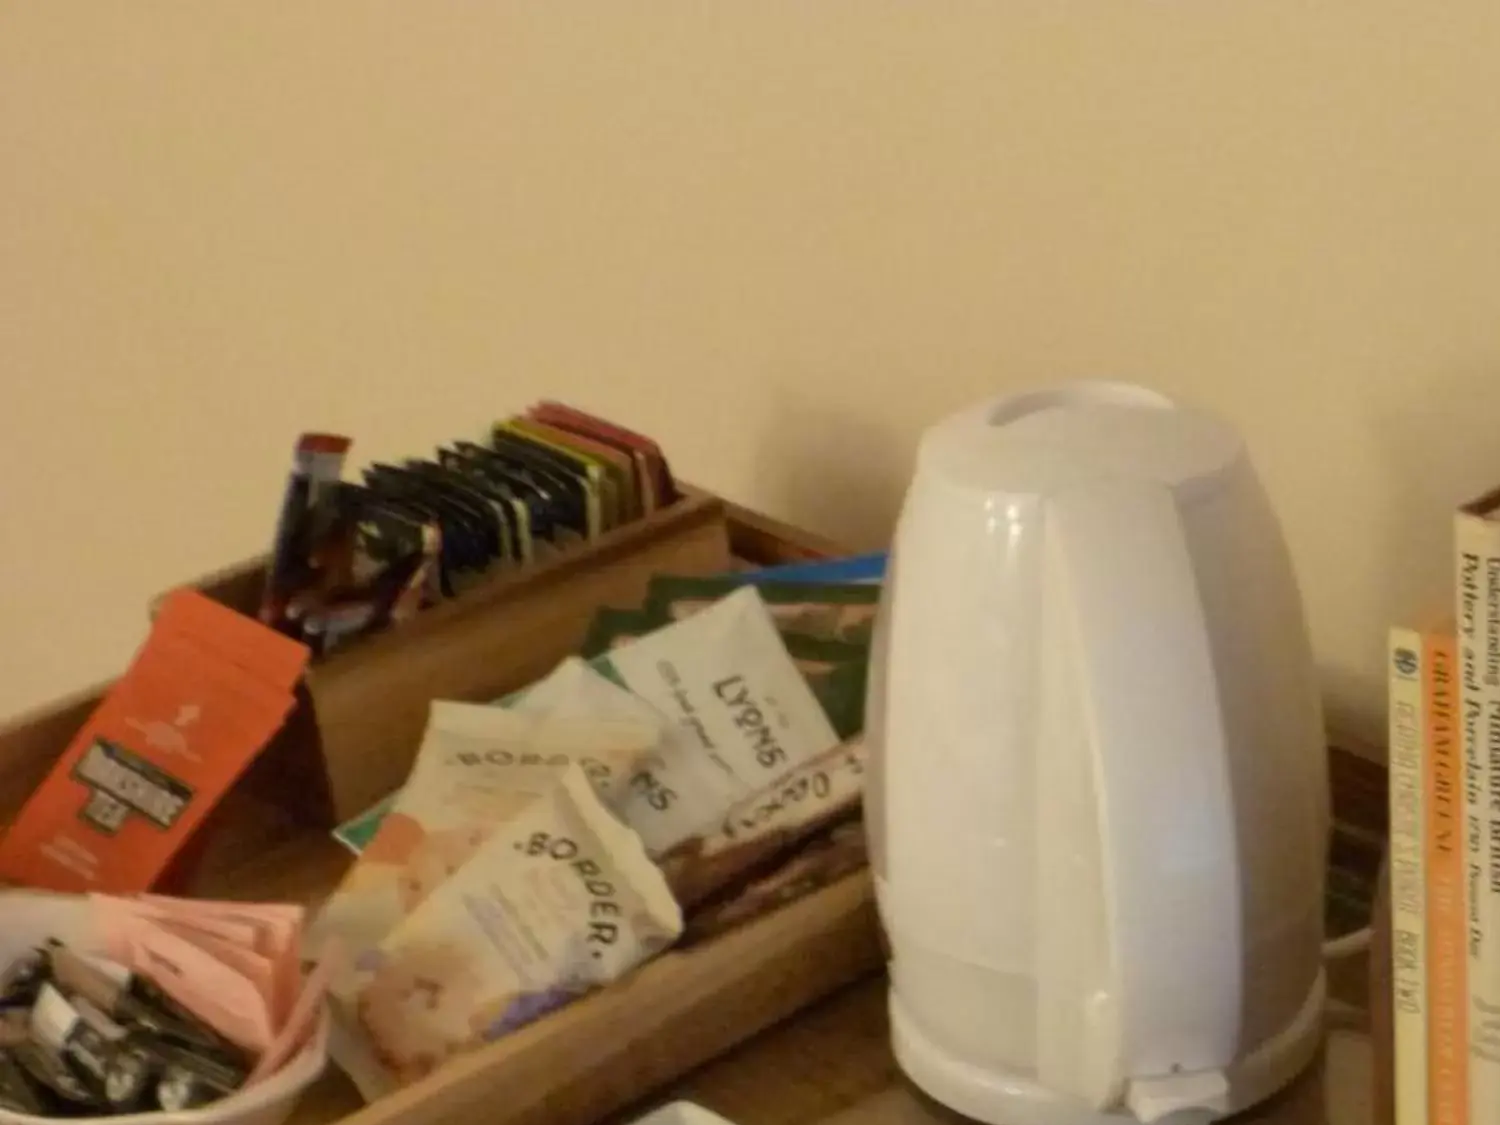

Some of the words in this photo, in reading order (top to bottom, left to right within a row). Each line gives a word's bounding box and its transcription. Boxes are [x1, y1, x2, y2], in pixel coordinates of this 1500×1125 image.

[1461, 552, 1479, 648] Pottery
[1432, 650, 1452, 754] GRAHAM
[1462, 645, 1481, 692] and
[1464, 697, 1482, 808] Porcelain
[1433, 757, 1453, 857] GREENE
[525, 831, 623, 946] BORDER
